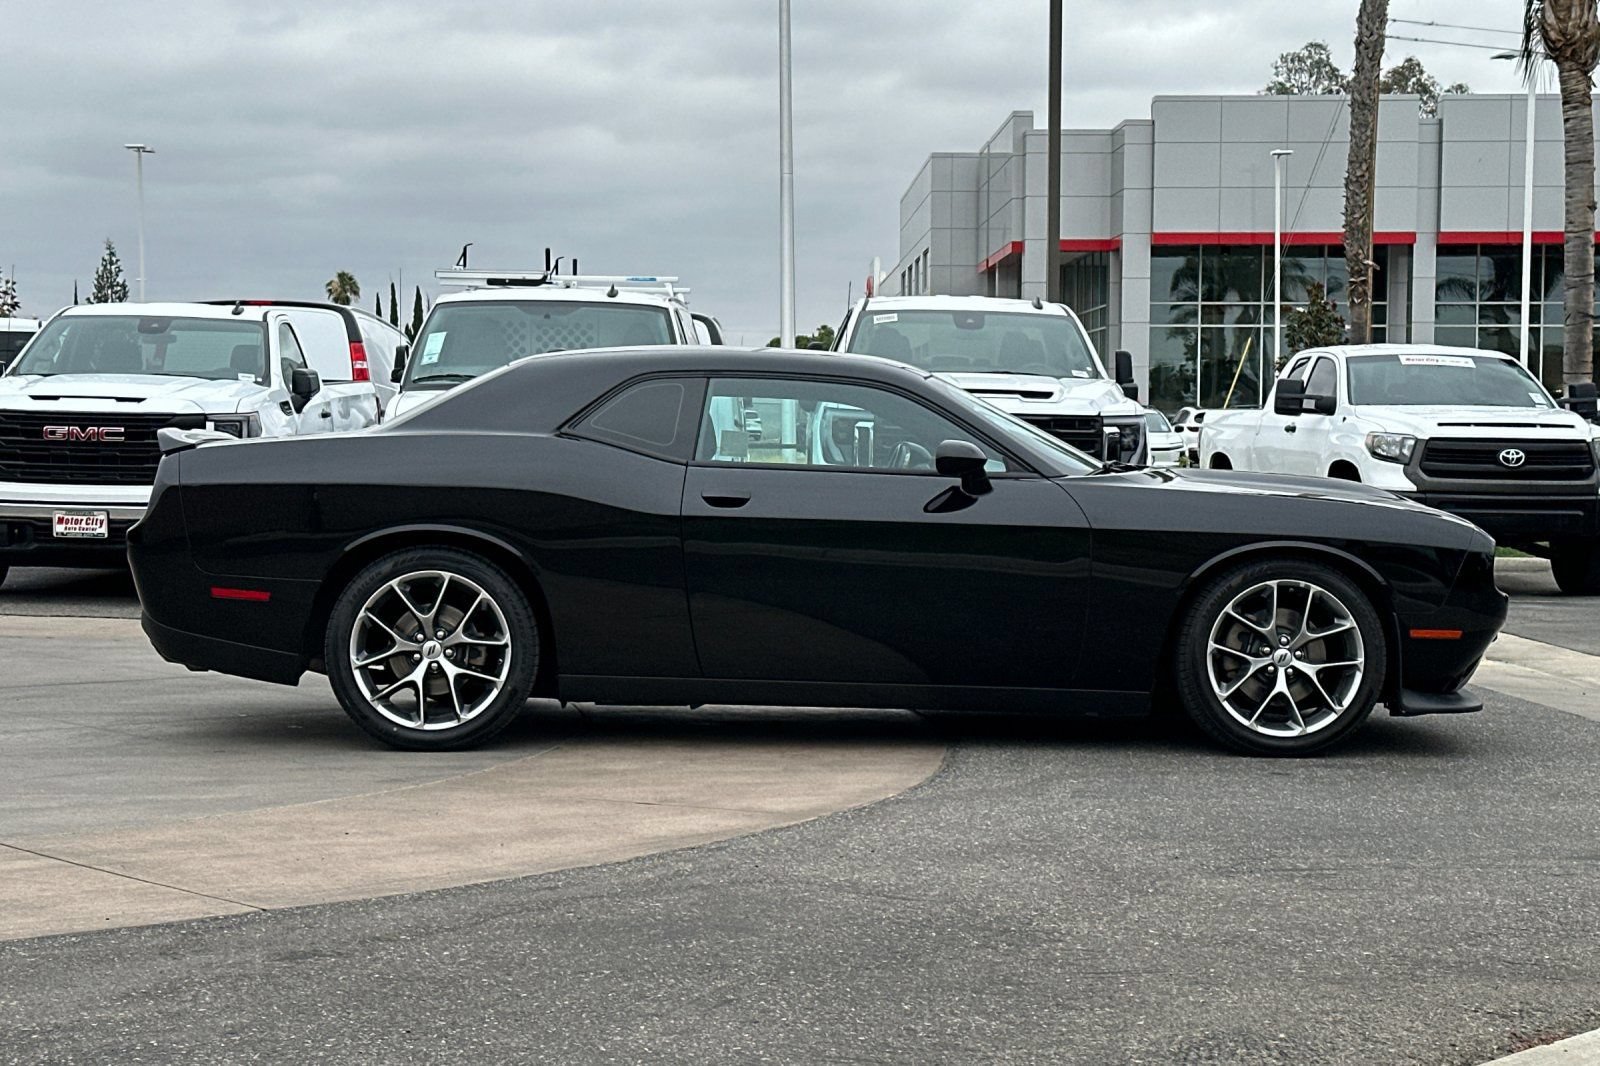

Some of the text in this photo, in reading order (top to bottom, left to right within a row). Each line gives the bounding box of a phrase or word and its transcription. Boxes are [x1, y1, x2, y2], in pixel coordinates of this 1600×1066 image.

[43, 425, 125, 441] GMC
[56, 516, 105, 528] Motor City
